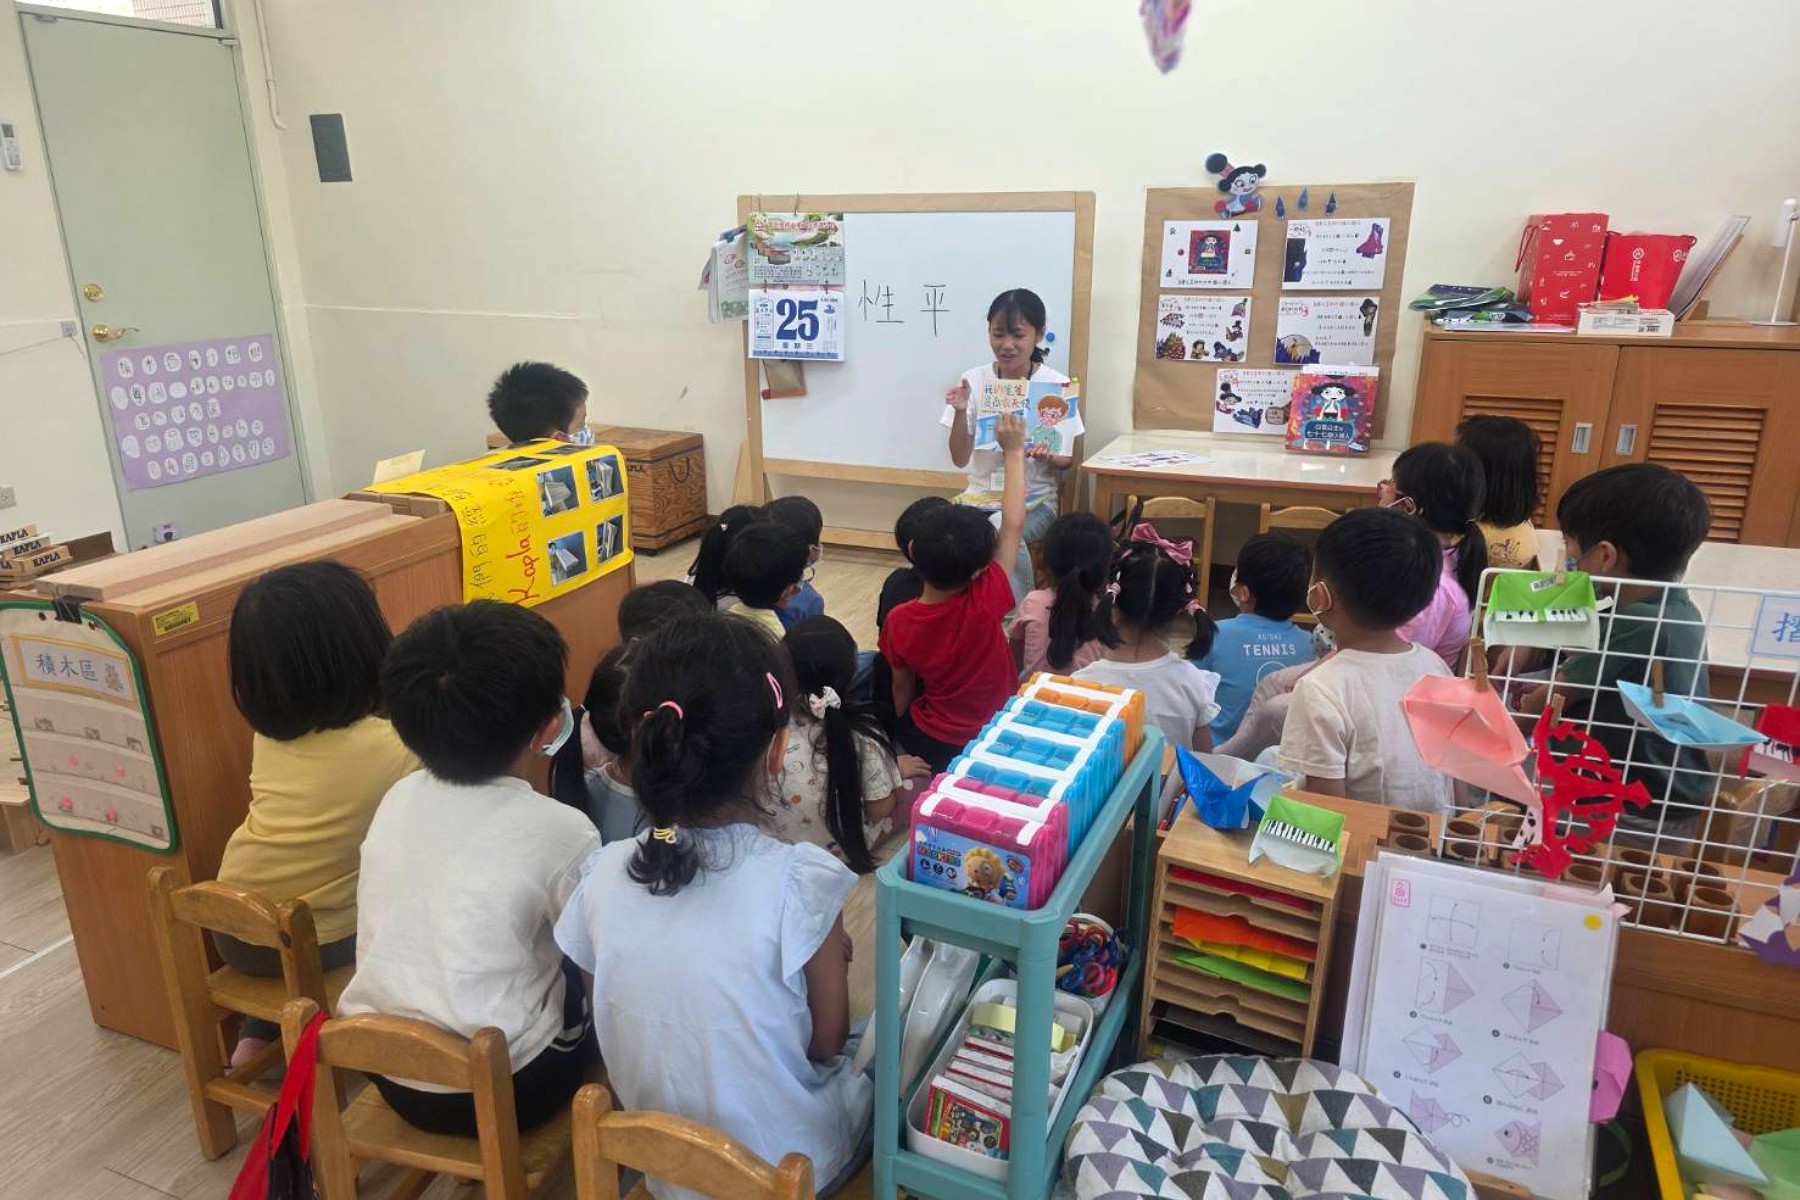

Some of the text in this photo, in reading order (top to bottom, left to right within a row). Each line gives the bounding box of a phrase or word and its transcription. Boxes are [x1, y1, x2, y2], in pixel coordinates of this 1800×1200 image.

[776, 299, 820, 341] 25
[0, 529, 29, 544] KAPLA
[14, 540, 42, 555] KAPLA
[33, 552, 61, 567] KAPLA
[1243, 644, 1296, 656] TENNIS
[35, 653, 98, 682] 積木區
